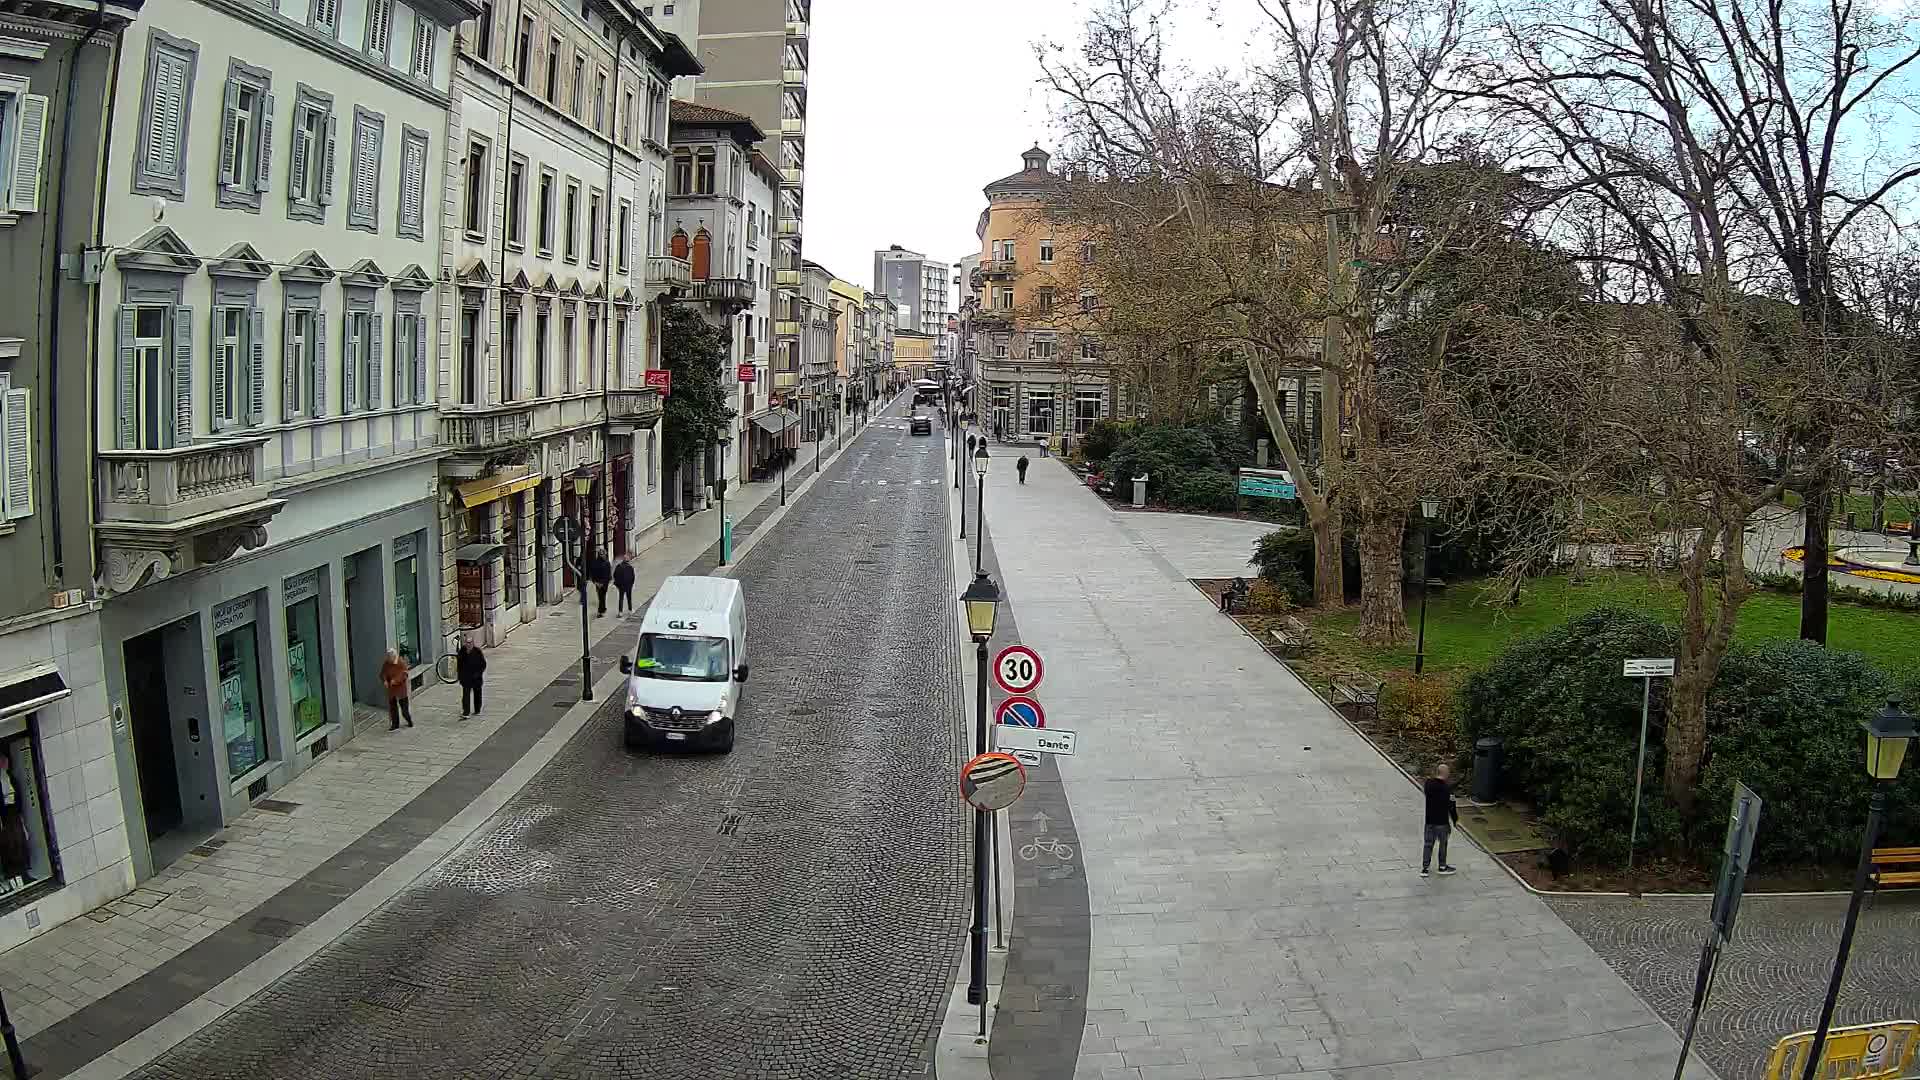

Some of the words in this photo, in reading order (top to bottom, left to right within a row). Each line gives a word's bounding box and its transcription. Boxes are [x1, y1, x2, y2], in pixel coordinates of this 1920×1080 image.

[668, 620, 698, 631] GLS
[1005, 658, 1033, 681] 30
[1038, 738, 1069, 750] Dante
